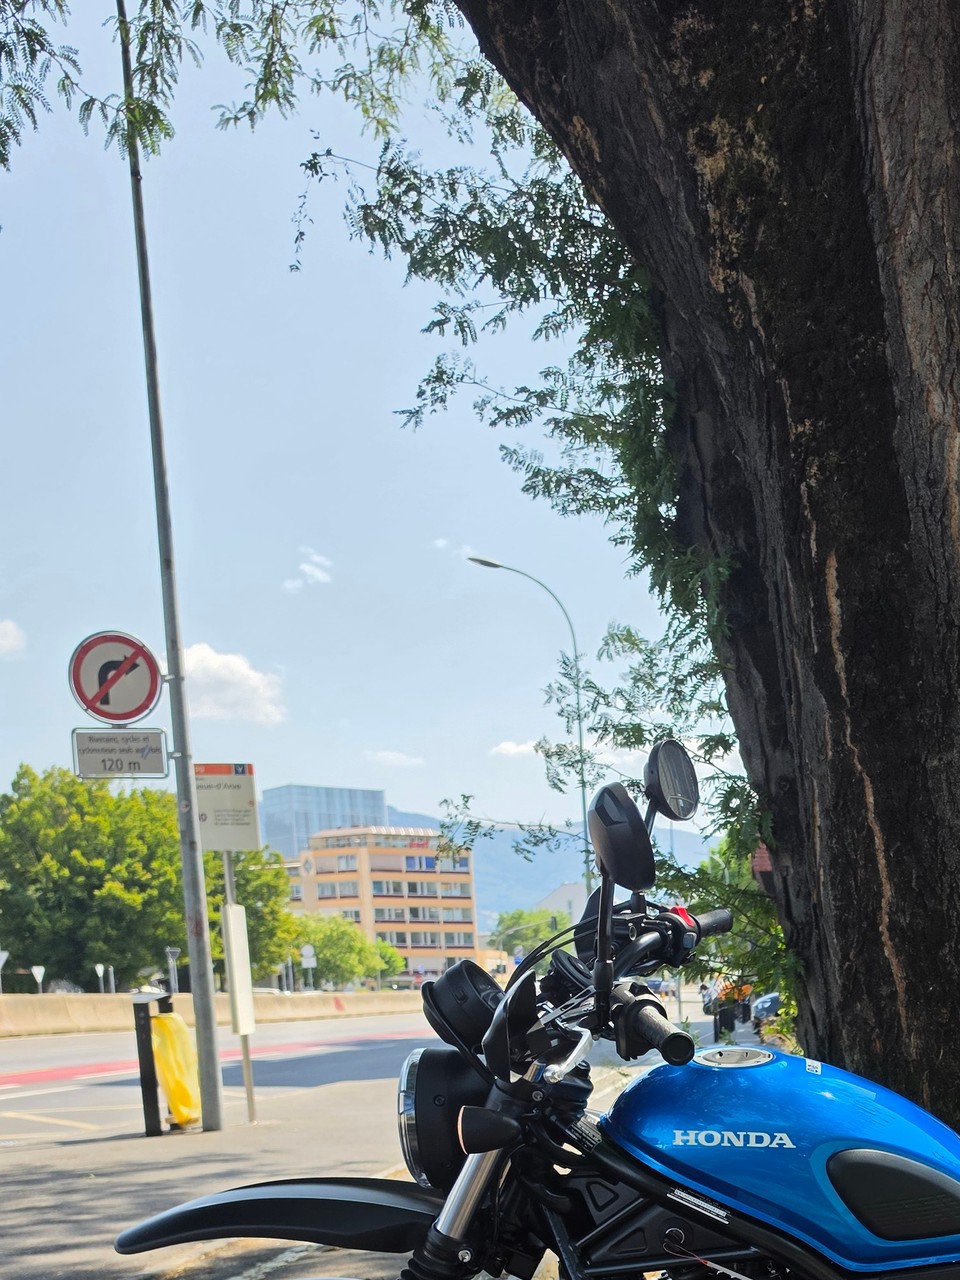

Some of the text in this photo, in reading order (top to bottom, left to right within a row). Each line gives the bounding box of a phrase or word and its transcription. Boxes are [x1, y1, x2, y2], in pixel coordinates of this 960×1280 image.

[101, 758, 141, 772] 120 m
[672, 1130, 797, 1149] HONDA
